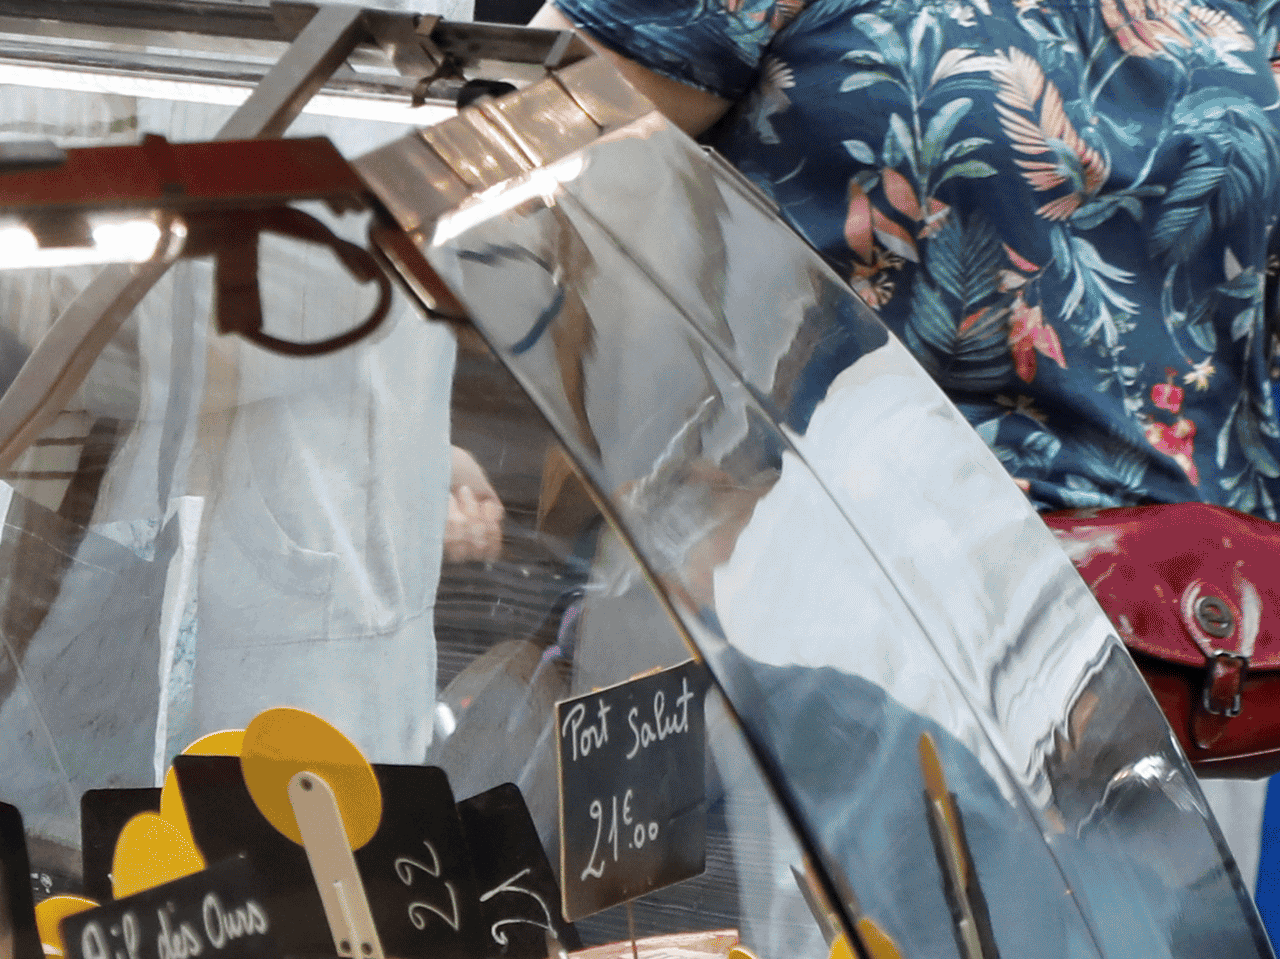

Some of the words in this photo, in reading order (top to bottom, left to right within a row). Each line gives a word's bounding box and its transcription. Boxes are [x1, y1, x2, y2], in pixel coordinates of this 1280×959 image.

[562, 698, 611, 762] Port
[626, 677, 694, 760] Salut
[202, 893, 268, 949] Ours
